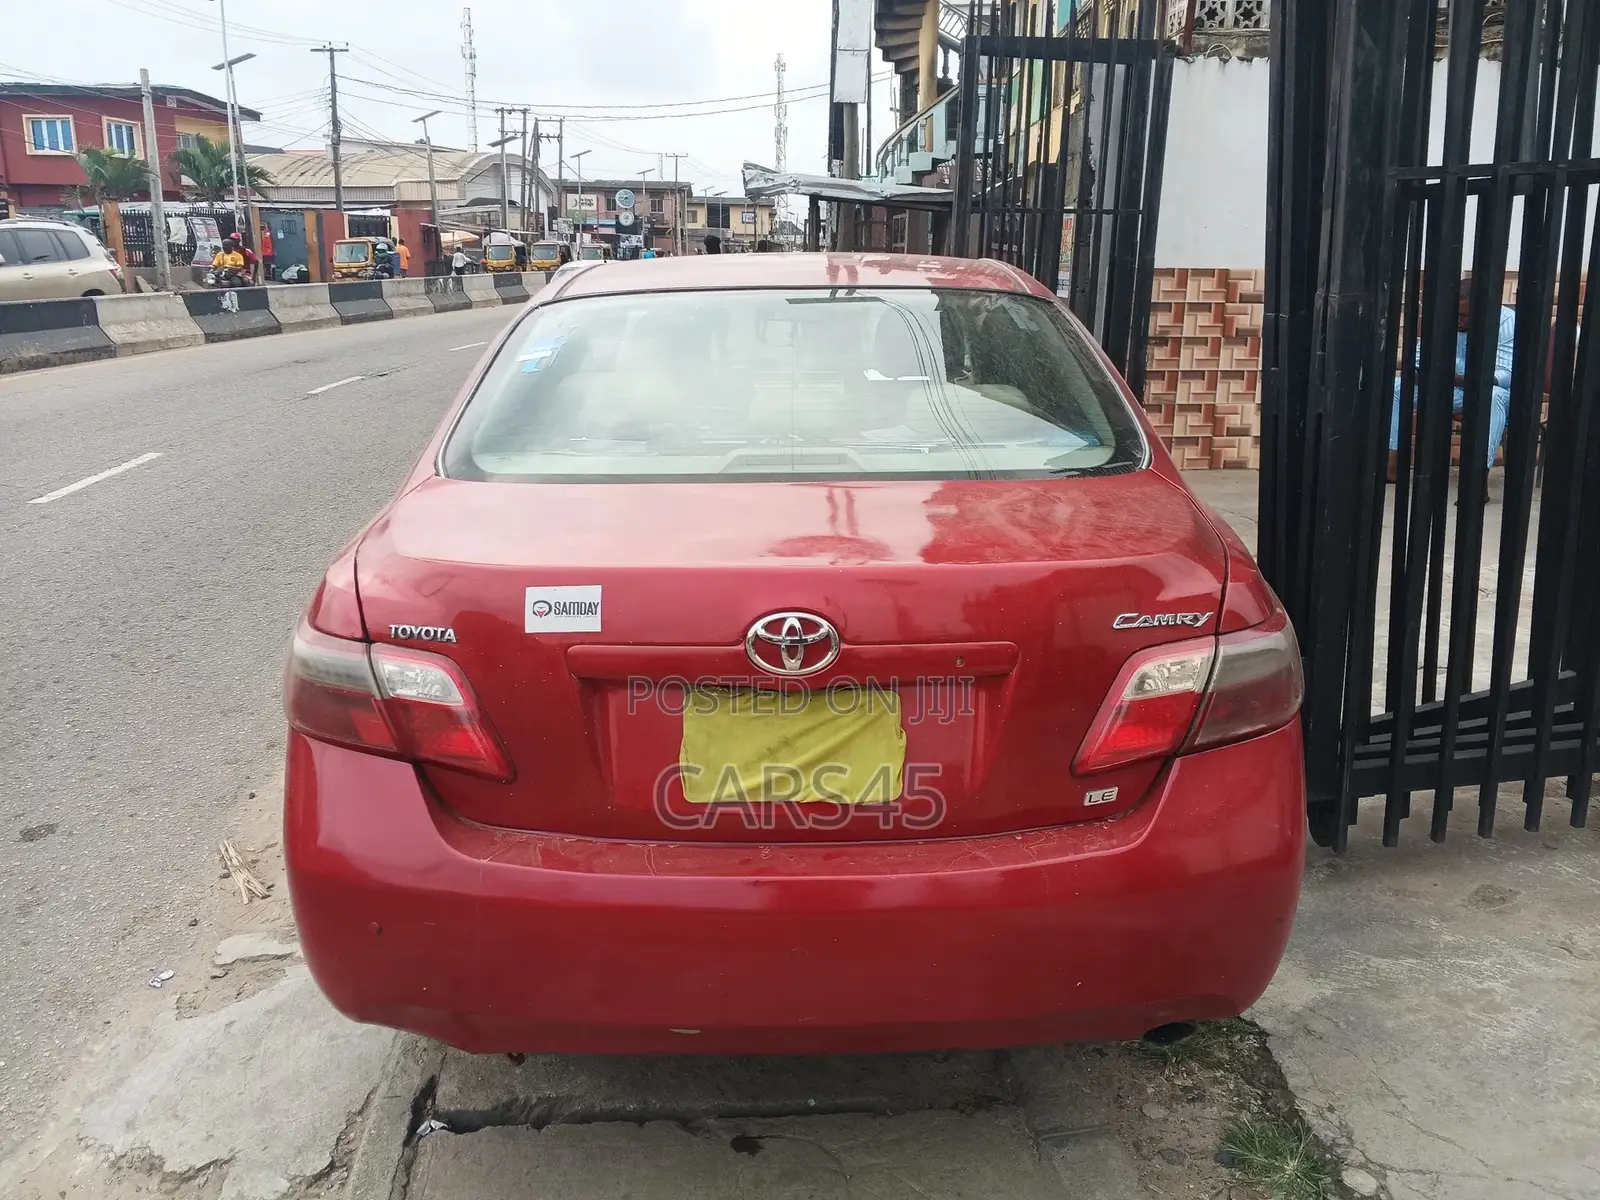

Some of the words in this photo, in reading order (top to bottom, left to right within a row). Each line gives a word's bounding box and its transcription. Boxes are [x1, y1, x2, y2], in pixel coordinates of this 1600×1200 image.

[554, 601, 600, 616] SAMDAY
[1112, 612, 1214, 630] CAMRY
[389, 624, 457, 643] TOYOTA
[1087, 789, 1116, 804] LE
